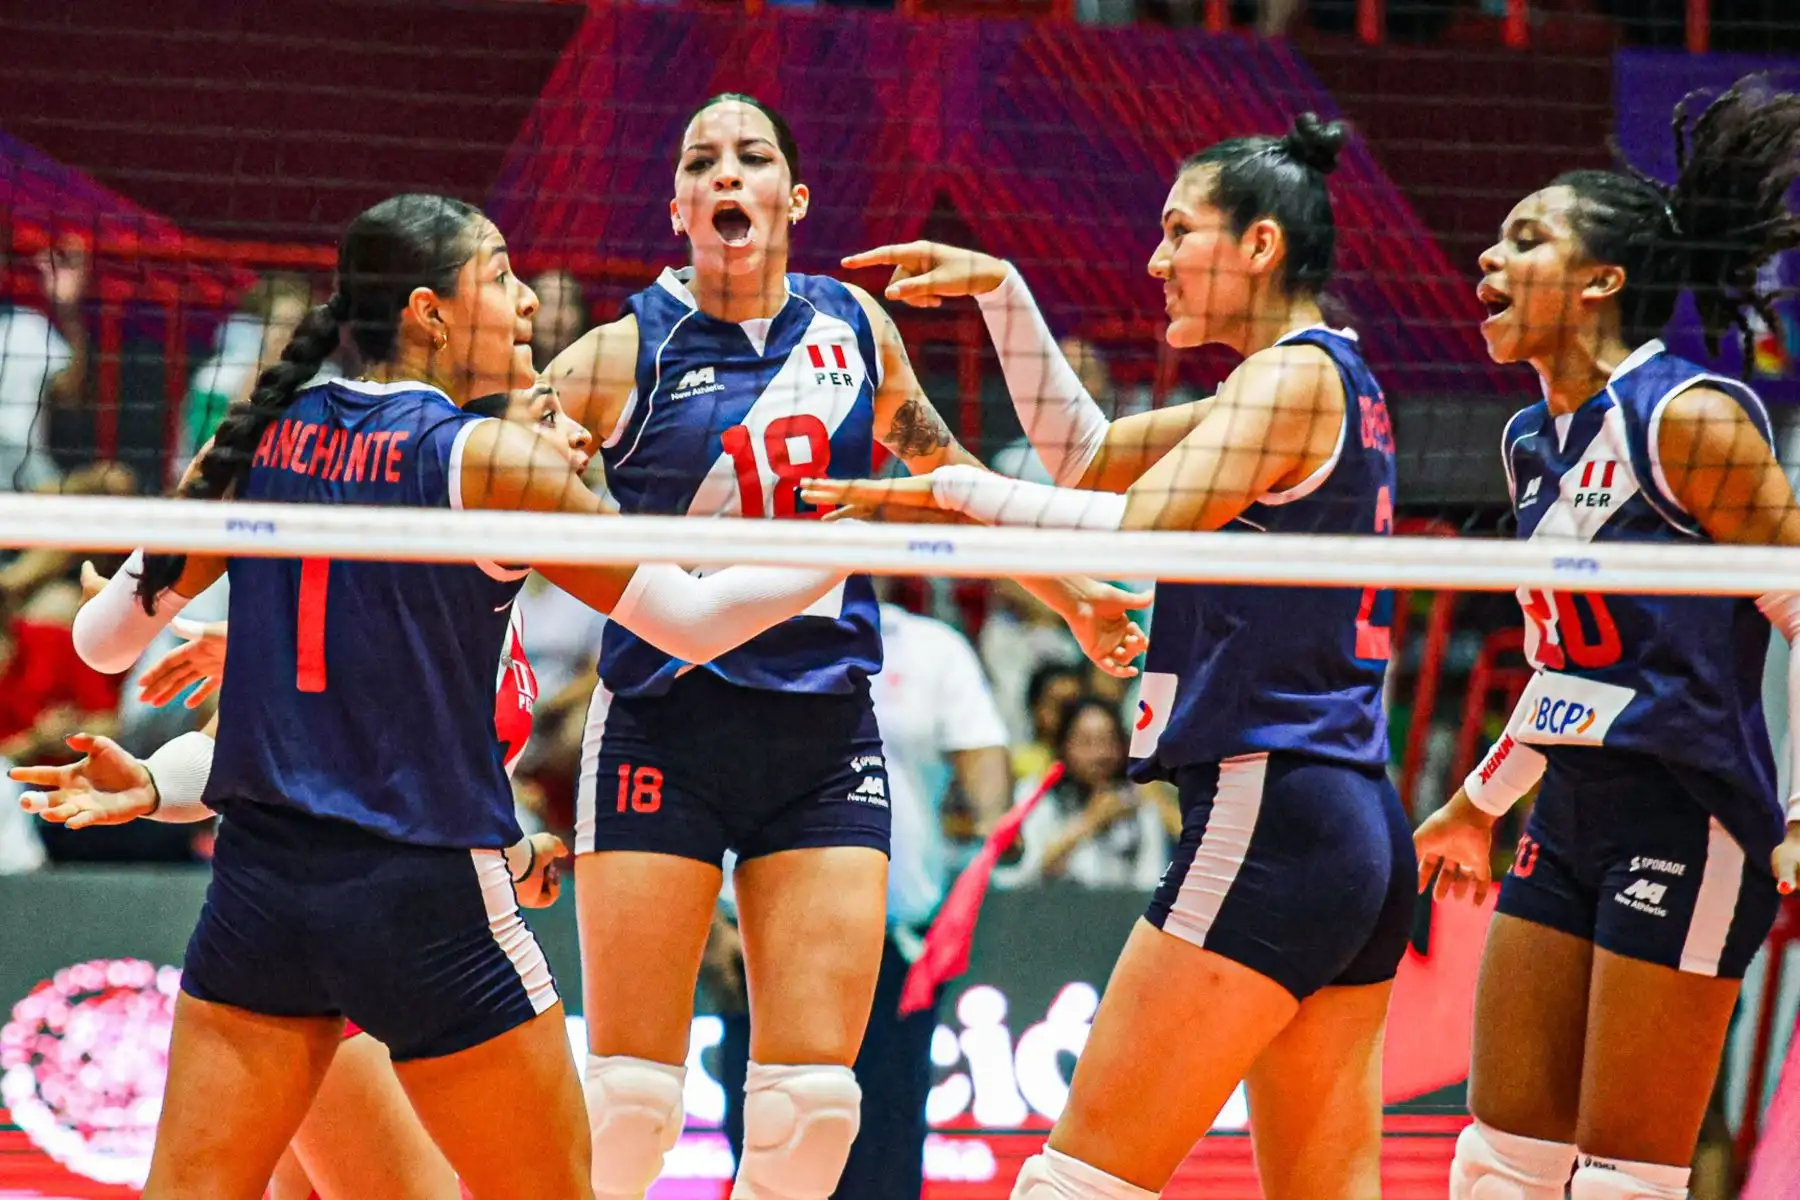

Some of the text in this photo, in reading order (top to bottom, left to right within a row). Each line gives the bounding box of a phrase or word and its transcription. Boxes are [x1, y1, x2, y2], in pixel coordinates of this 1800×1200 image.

[813, 372, 854, 387] PER
[1574, 492, 1612, 508] PER
[1535, 696, 1585, 735] BCP
[616, 763, 664, 813] 18
